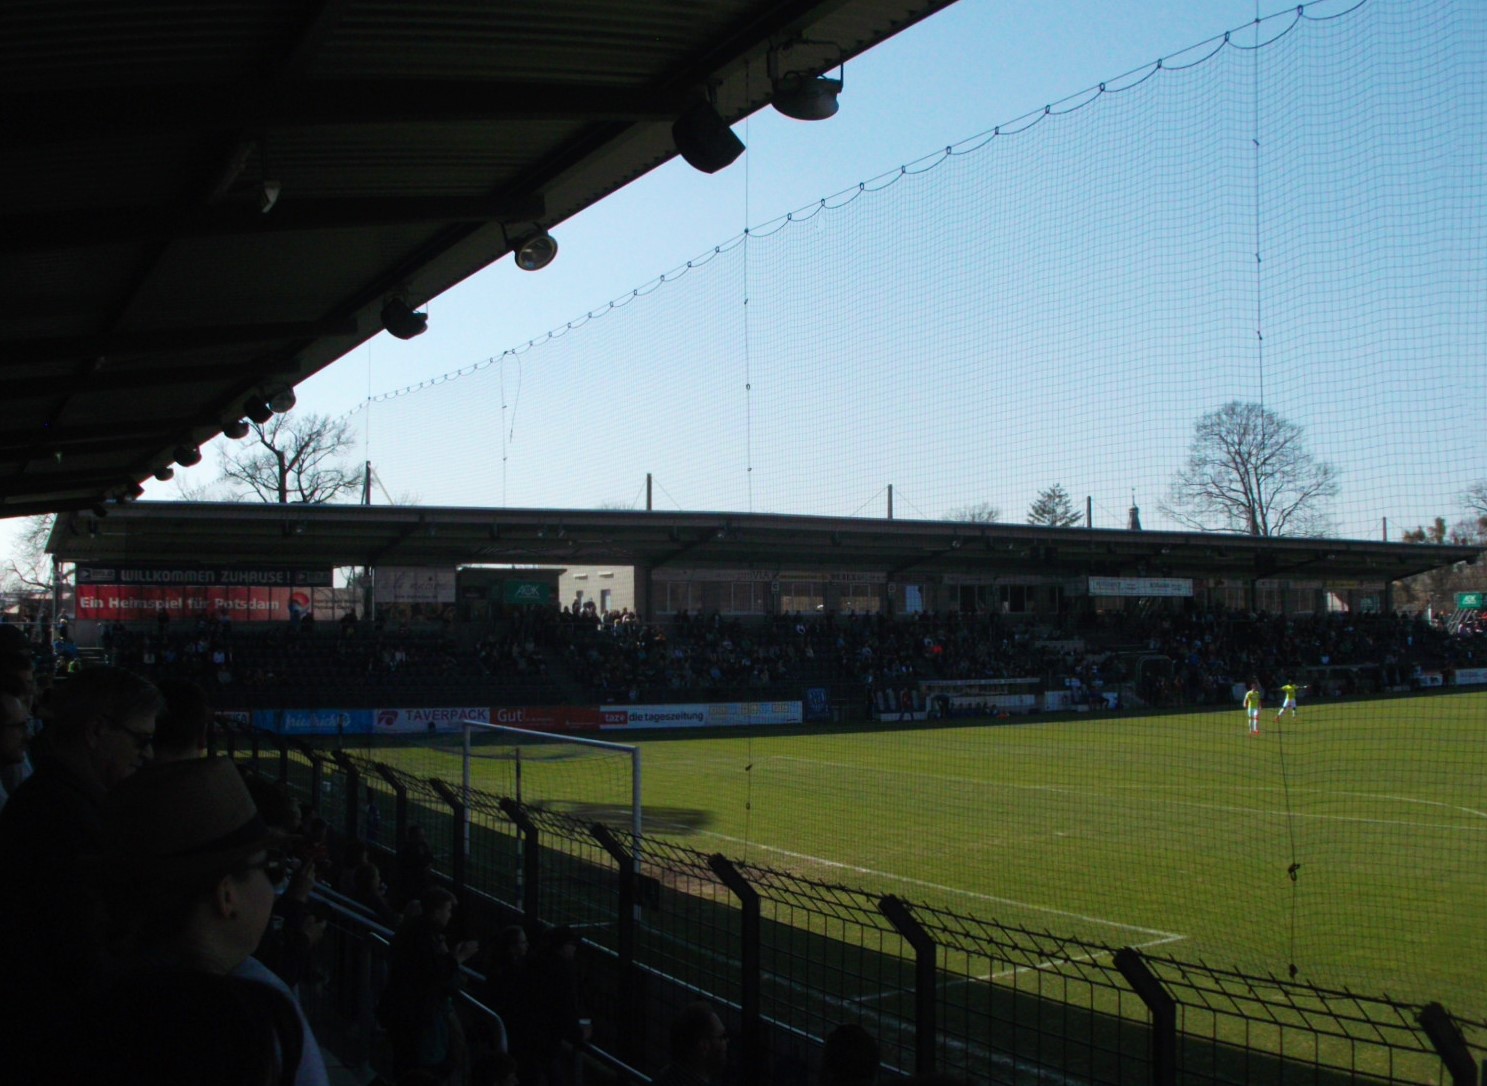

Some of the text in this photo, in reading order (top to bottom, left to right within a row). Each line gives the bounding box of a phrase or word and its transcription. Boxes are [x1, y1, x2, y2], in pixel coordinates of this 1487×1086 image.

[121, 570, 215, 584] WILLKOMMEN
[220, 570, 290, 584] ZUHAUSE!
[80, 597, 280, 612] Ein Heimspiel für Potsdam
[405, 709, 486, 721] TAVERPACK
[496, 708, 523, 722] Gut
[629, 711, 644, 721] die
[645, 710, 704, 723] tageszeitung
